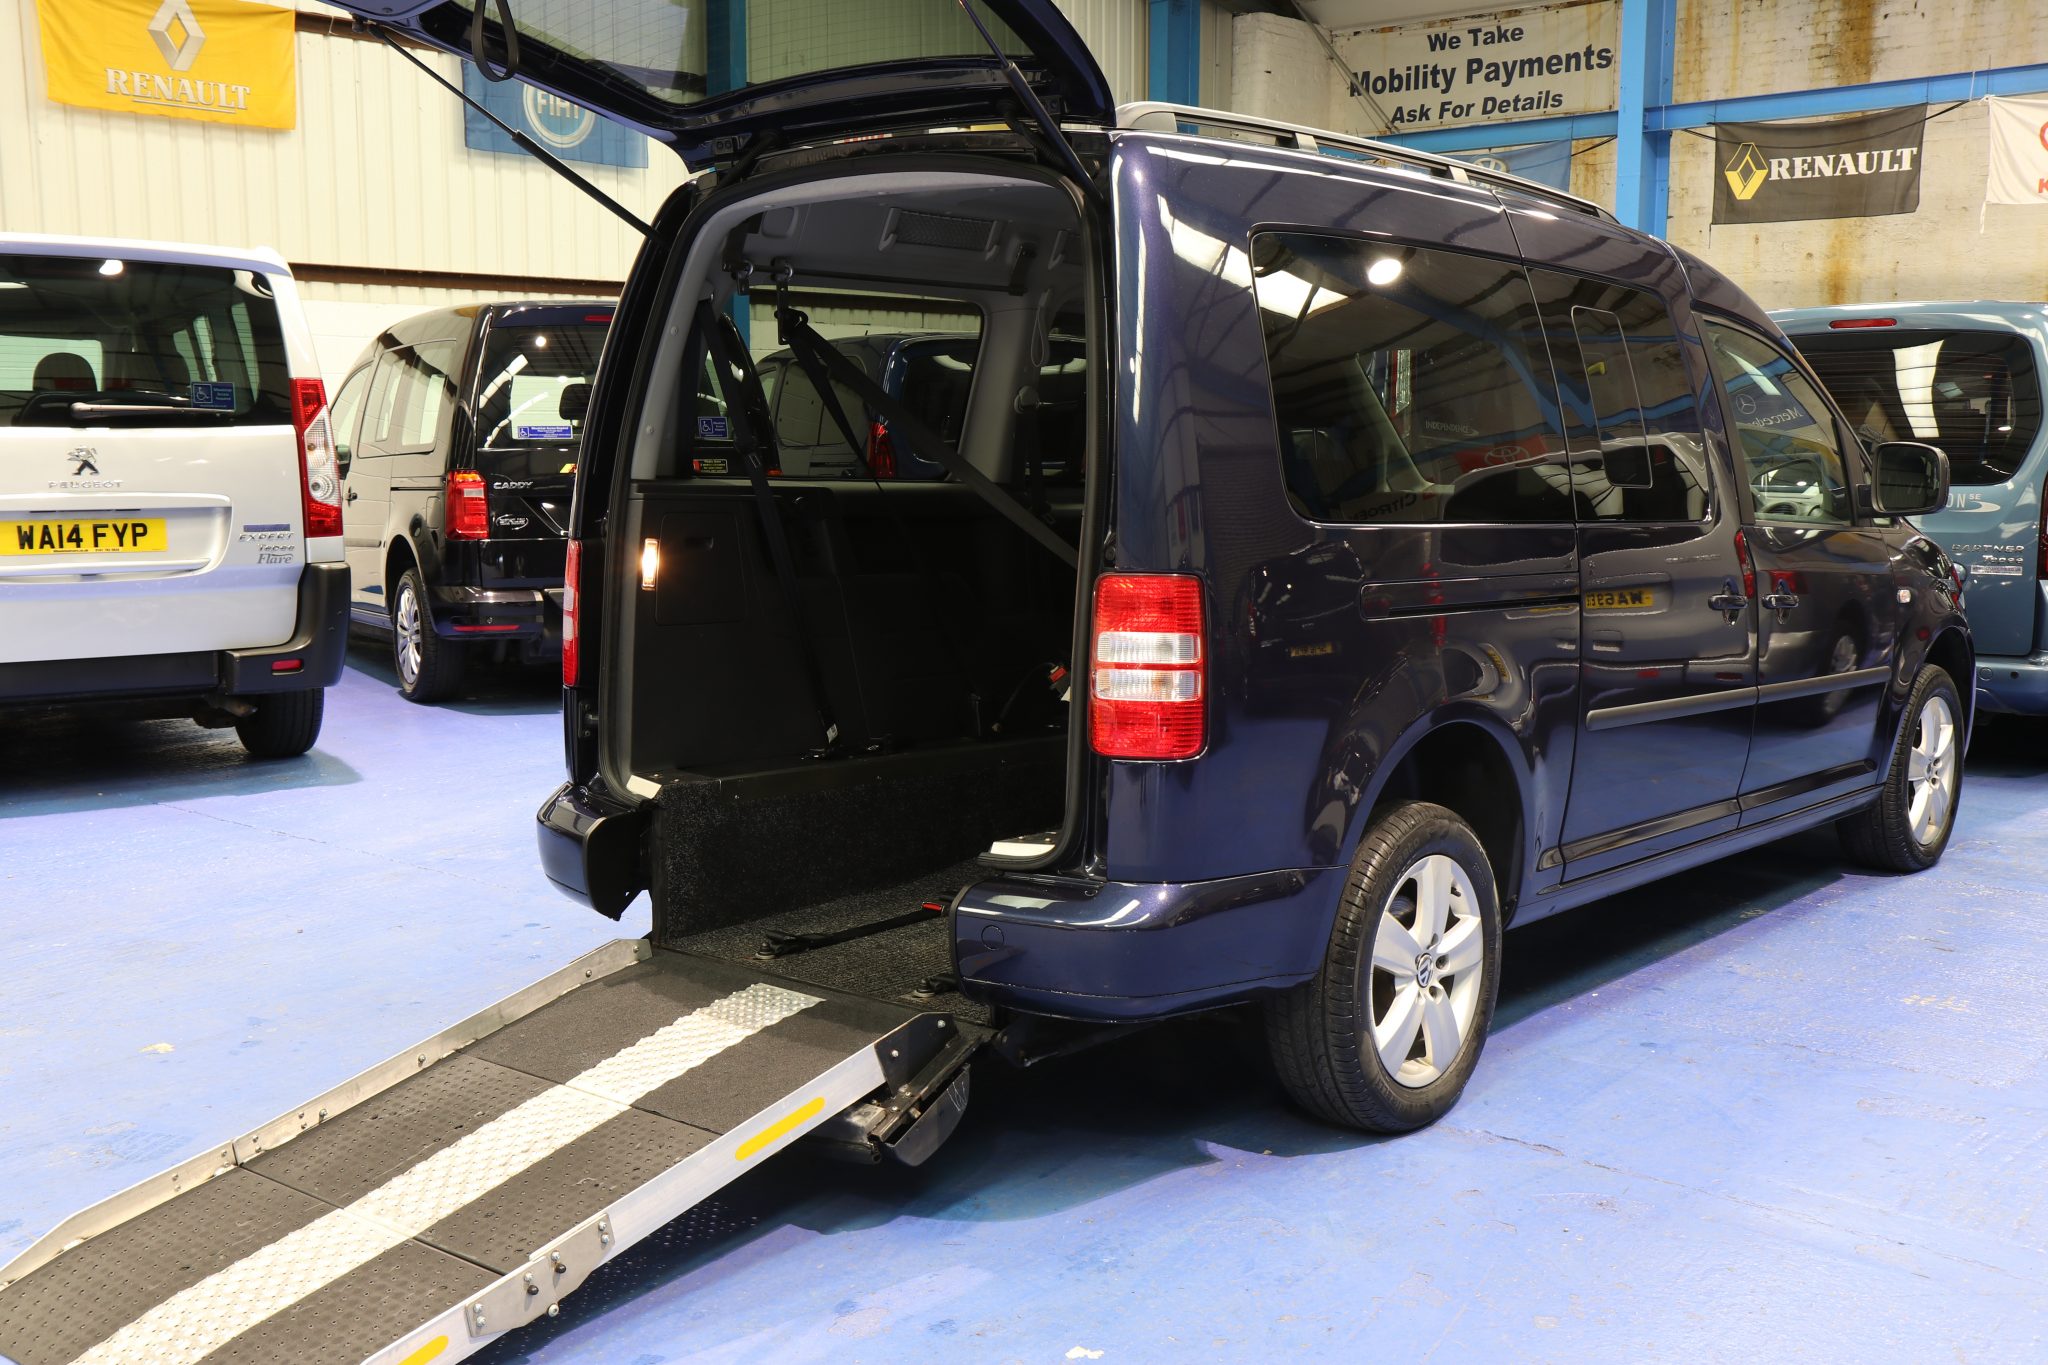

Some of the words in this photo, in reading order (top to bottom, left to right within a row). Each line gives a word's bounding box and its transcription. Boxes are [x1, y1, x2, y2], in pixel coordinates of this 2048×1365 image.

[1427, 33, 1461, 52] We
[1468, 26, 1524, 48] Take
[1350, 63, 1457, 97] Mobility
[1466, 44, 1613, 87] Payments
[105, 68, 250, 110] RENAULT
[1390, 104, 1430, 124] Ask
[1438, 101, 1475, 119] For
[1482, 91, 1563, 115] Details
[1768, 147, 1918, 181] RENAULT
[48, 480, 124, 489] PEUGEOT
[493, 481, 534, 490] CADDY
[17, 524, 84, 550] WA14
[92, 523, 148, 548] FYP
[239, 531, 295, 541] EXPERT
[1951, 543, 2025, 553] PARTNER
[258, 553, 294, 564] Flare
